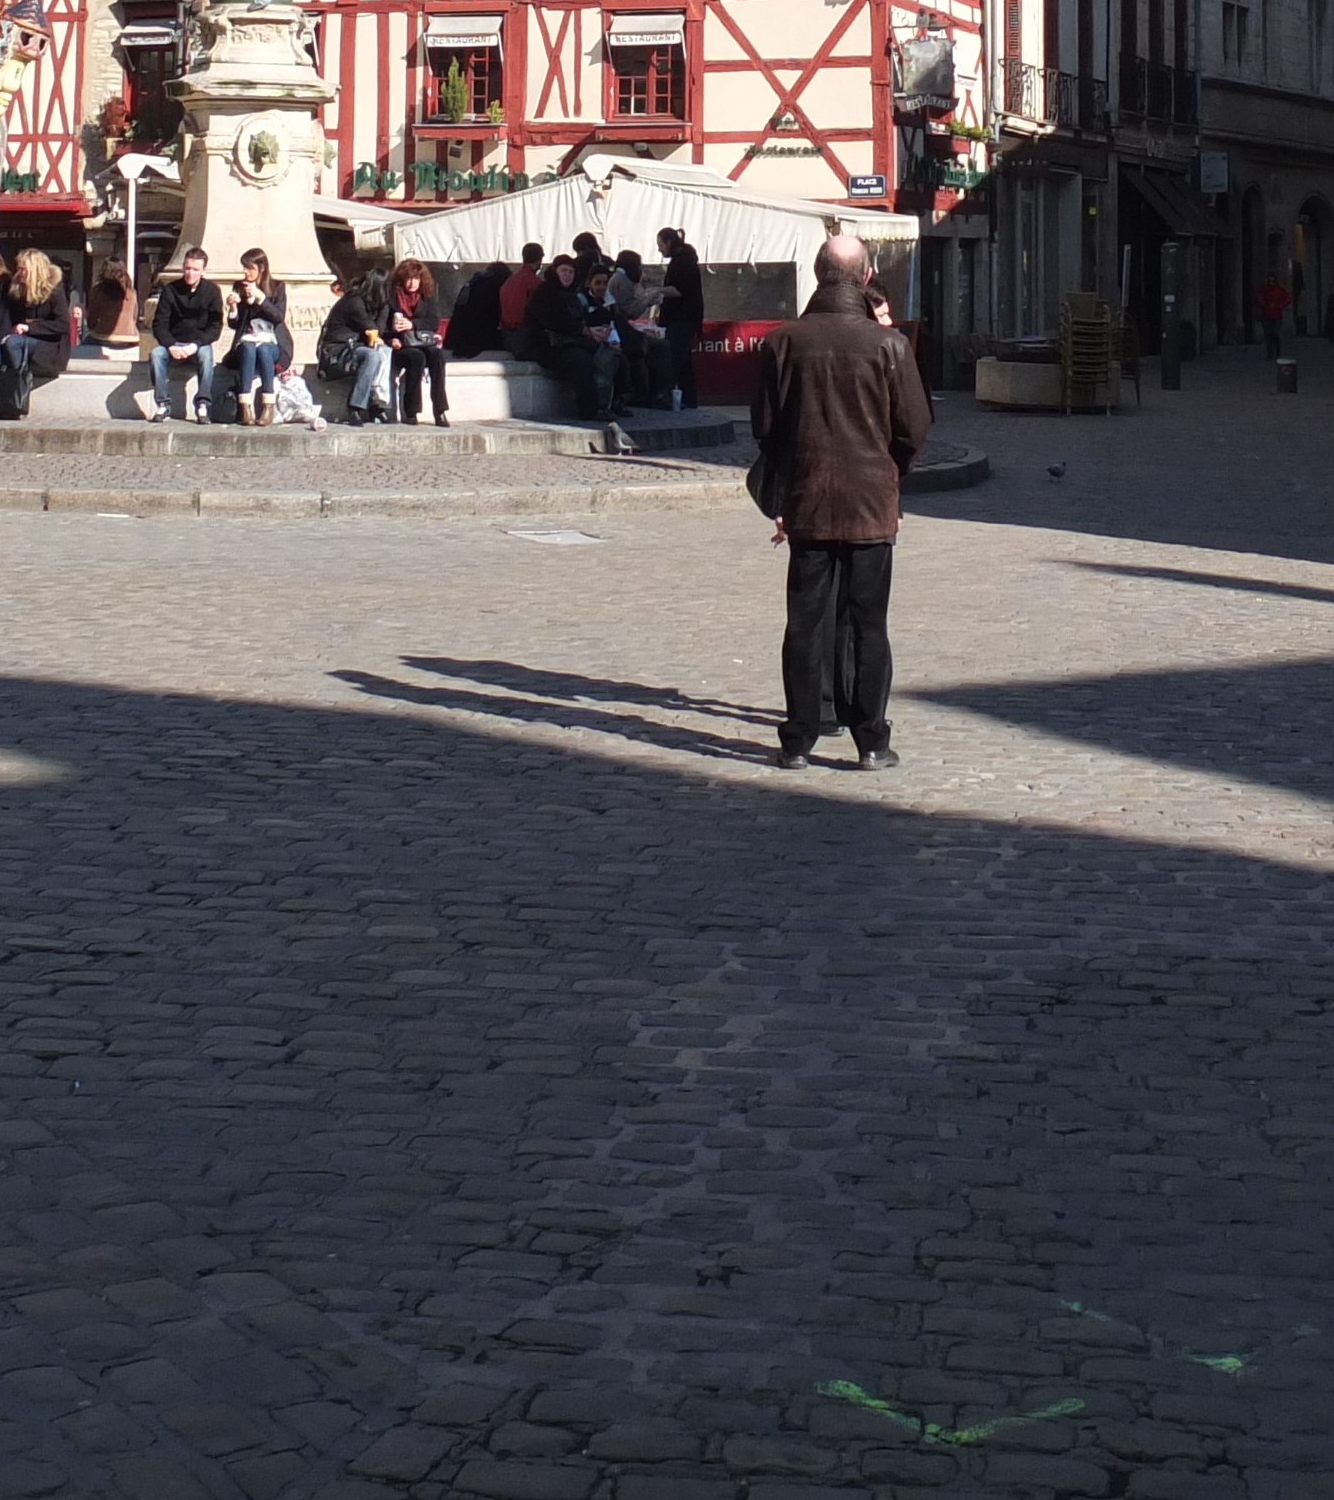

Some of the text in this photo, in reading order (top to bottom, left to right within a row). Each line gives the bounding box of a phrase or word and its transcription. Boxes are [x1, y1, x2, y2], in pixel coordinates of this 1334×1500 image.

[354, 162, 398, 192] Au
[411, 163, 530, 191] Moulin
[691, 338, 731, 353] rant
